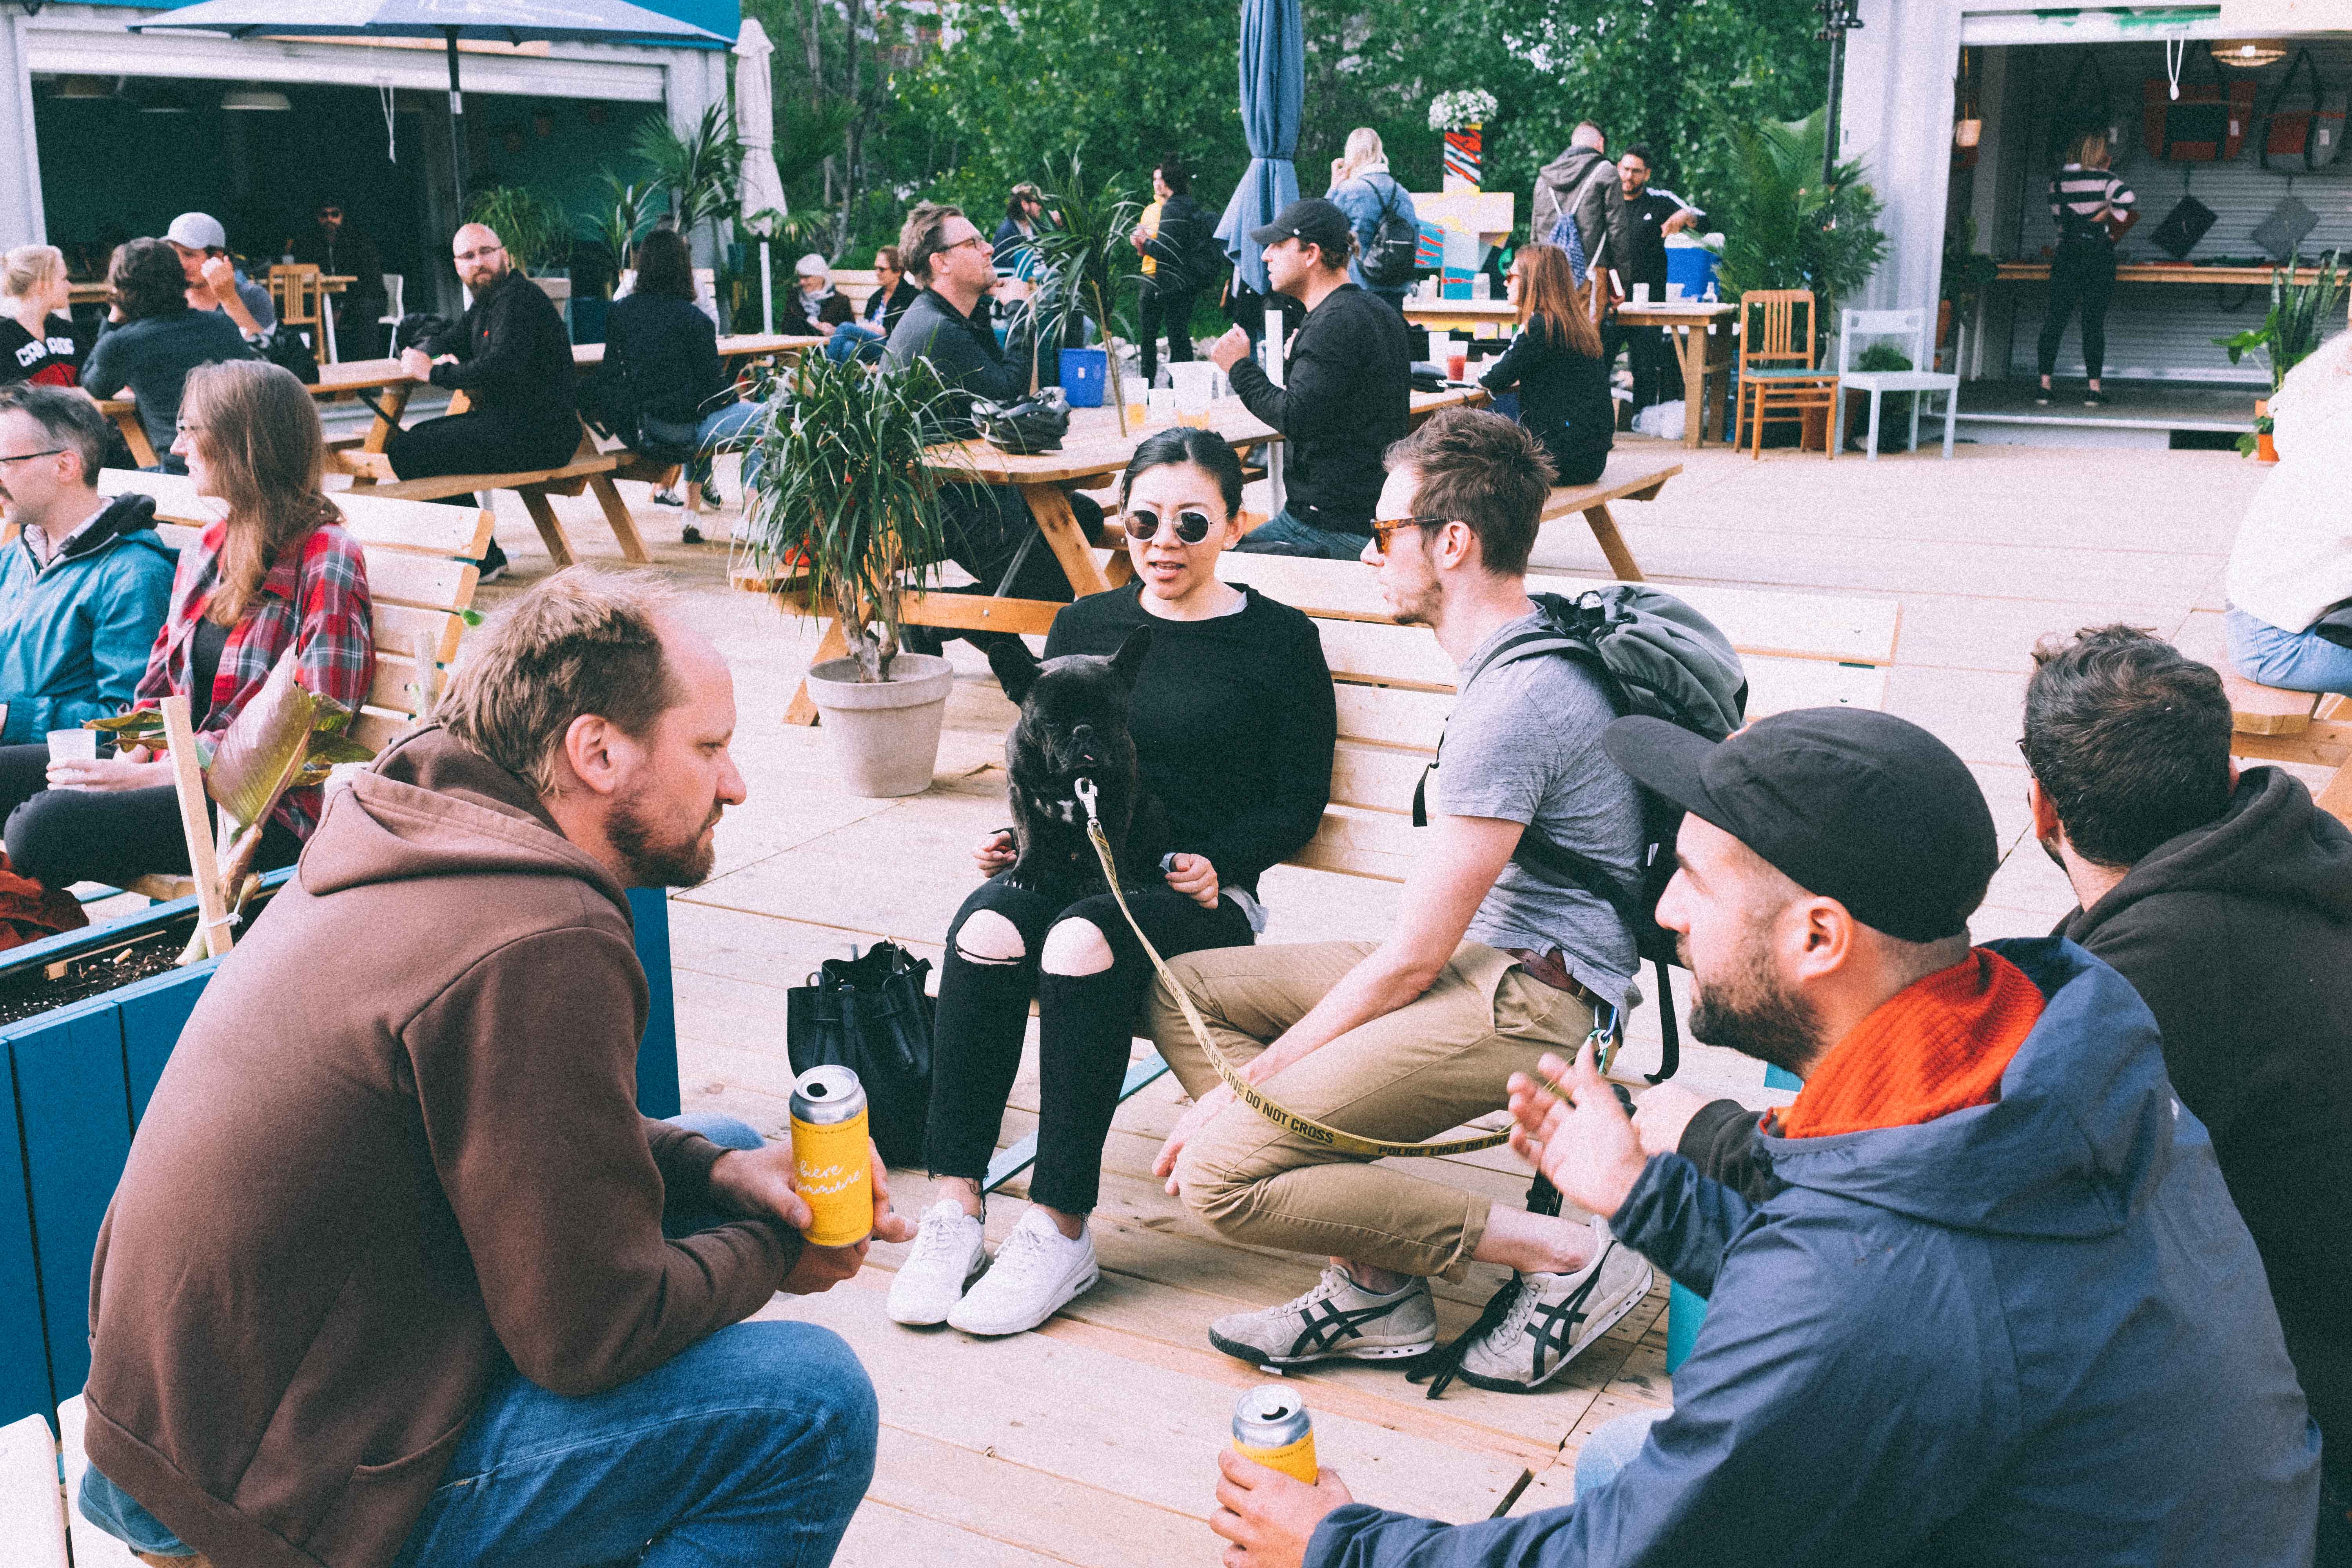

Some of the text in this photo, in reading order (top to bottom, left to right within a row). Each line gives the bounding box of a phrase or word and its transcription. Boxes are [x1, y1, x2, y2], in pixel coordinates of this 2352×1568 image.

[1200, 1031, 1335, 1144] POLICE LINE DO NOT CROSS
[1378, 1145, 1426, 1156] POLICE
[1430, 1142, 1461, 1156] LINE
[1465, 1139, 1483, 1151] DO
